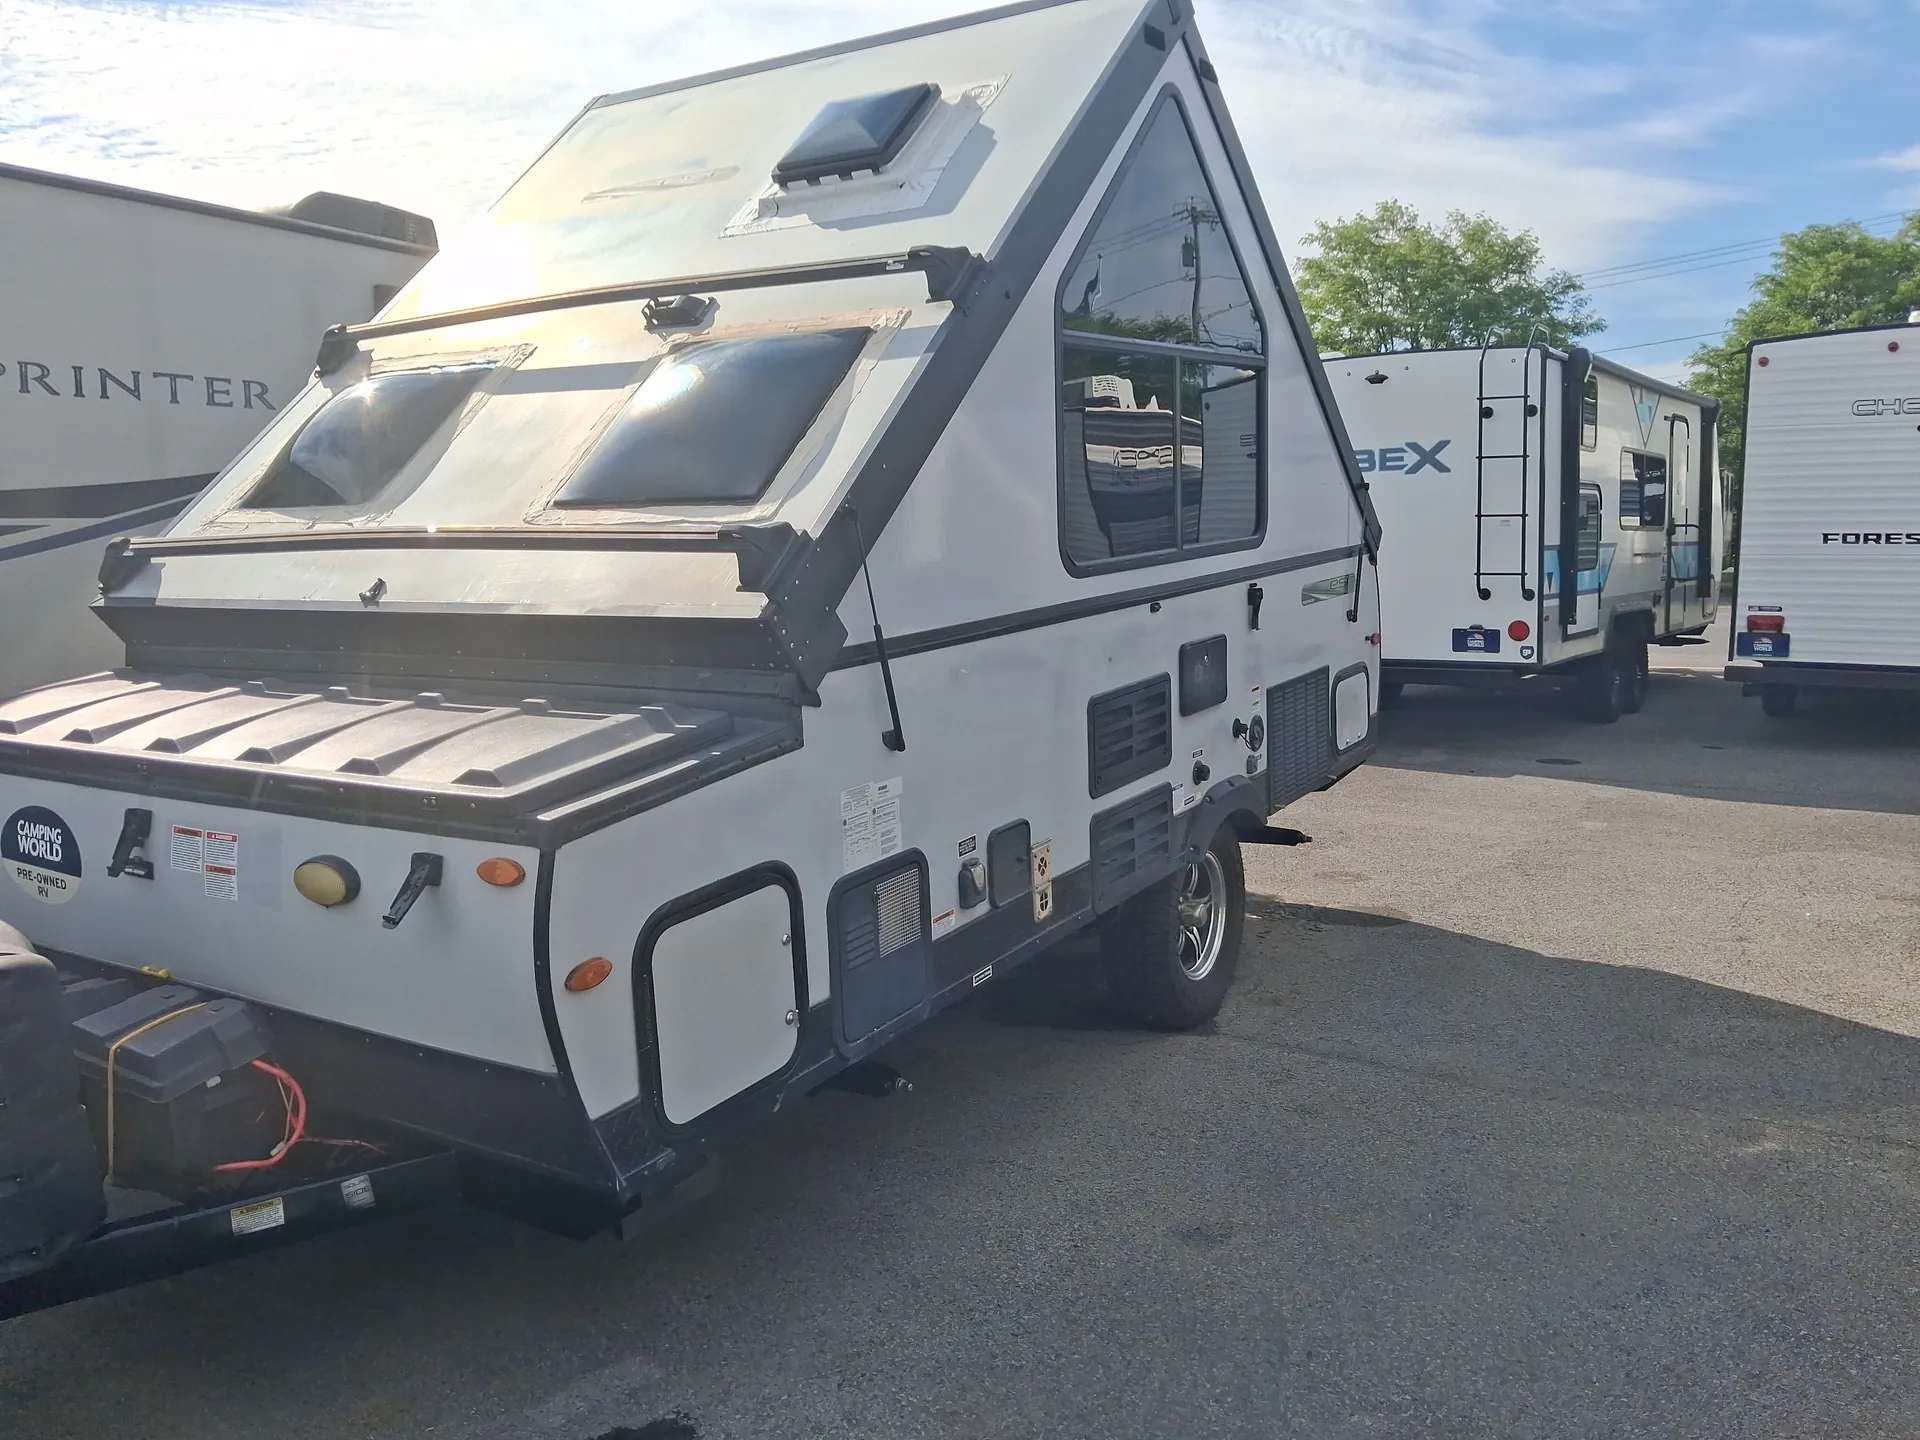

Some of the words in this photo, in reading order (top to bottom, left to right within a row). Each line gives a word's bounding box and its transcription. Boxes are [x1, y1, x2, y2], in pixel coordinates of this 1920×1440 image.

[0, 360, 277, 411] RINTER
[1851, 398, 1920, 417] CHE
[1822, 532, 1920, 545] FORES
[17, 819, 62, 844] CAMPING
[17, 835, 62, 862] WORLD
[16, 867, 67, 890] PRE-OWNED
[37, 886, 49, 898] RV
